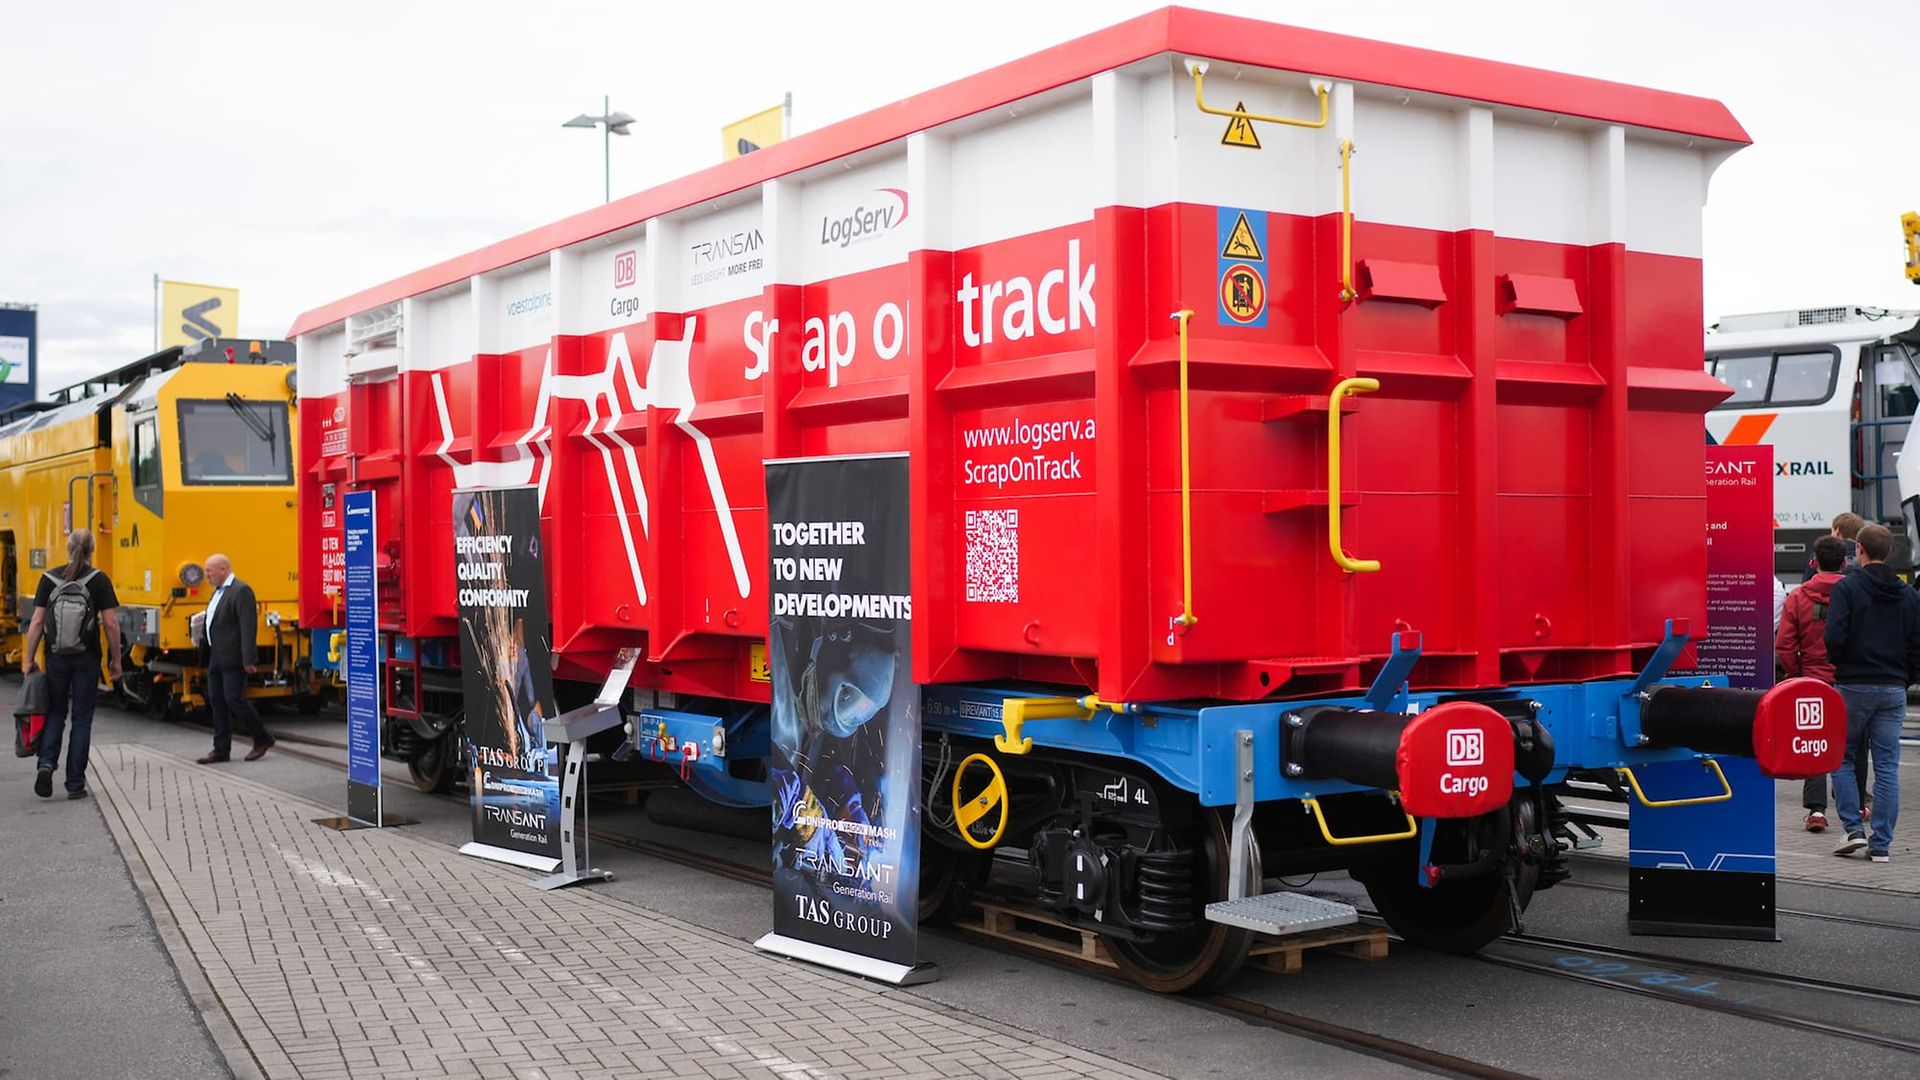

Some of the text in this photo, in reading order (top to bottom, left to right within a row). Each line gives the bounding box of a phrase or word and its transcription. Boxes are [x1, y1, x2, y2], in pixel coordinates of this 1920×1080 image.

[821, 205, 894, 248] LogServ
[727, 262, 747, 276] MORE
[957, 238, 1096, 348] track
[610, 297, 639, 317] Cargo
[964, 451, 1082, 489] ScrapOnTrack
[1776, 461, 1834, 476] XRAIL
[1741, 477, 1757, 486] Rail
[456, 535, 512, 554] EFFICIENCY
[773, 522, 865, 546] TOGETHER
[458, 562, 503, 580] QUALITY
[773, 557, 843, 581] TO NEW
[459, 588, 530, 607] CONFORMITY
[774, 593, 912, 620] DEVELOPMENTS
[1800, 703, 1820, 725] DB
[480, 746, 504, 767] TAS
[1451, 735, 1480, 760] DB
[1792, 736, 1828, 757] Cargo
[1440, 773, 1489, 797] Cargo
[1134, 788, 1149, 805] 4L
[484, 805, 546, 830] TRANSANT
[510, 829, 547, 844] Generation Rail
[795, 847, 894, 884] TRANSANT
[832, 882, 894, 904] Generation Rail
[795, 894, 892, 938] TAS GROUP
